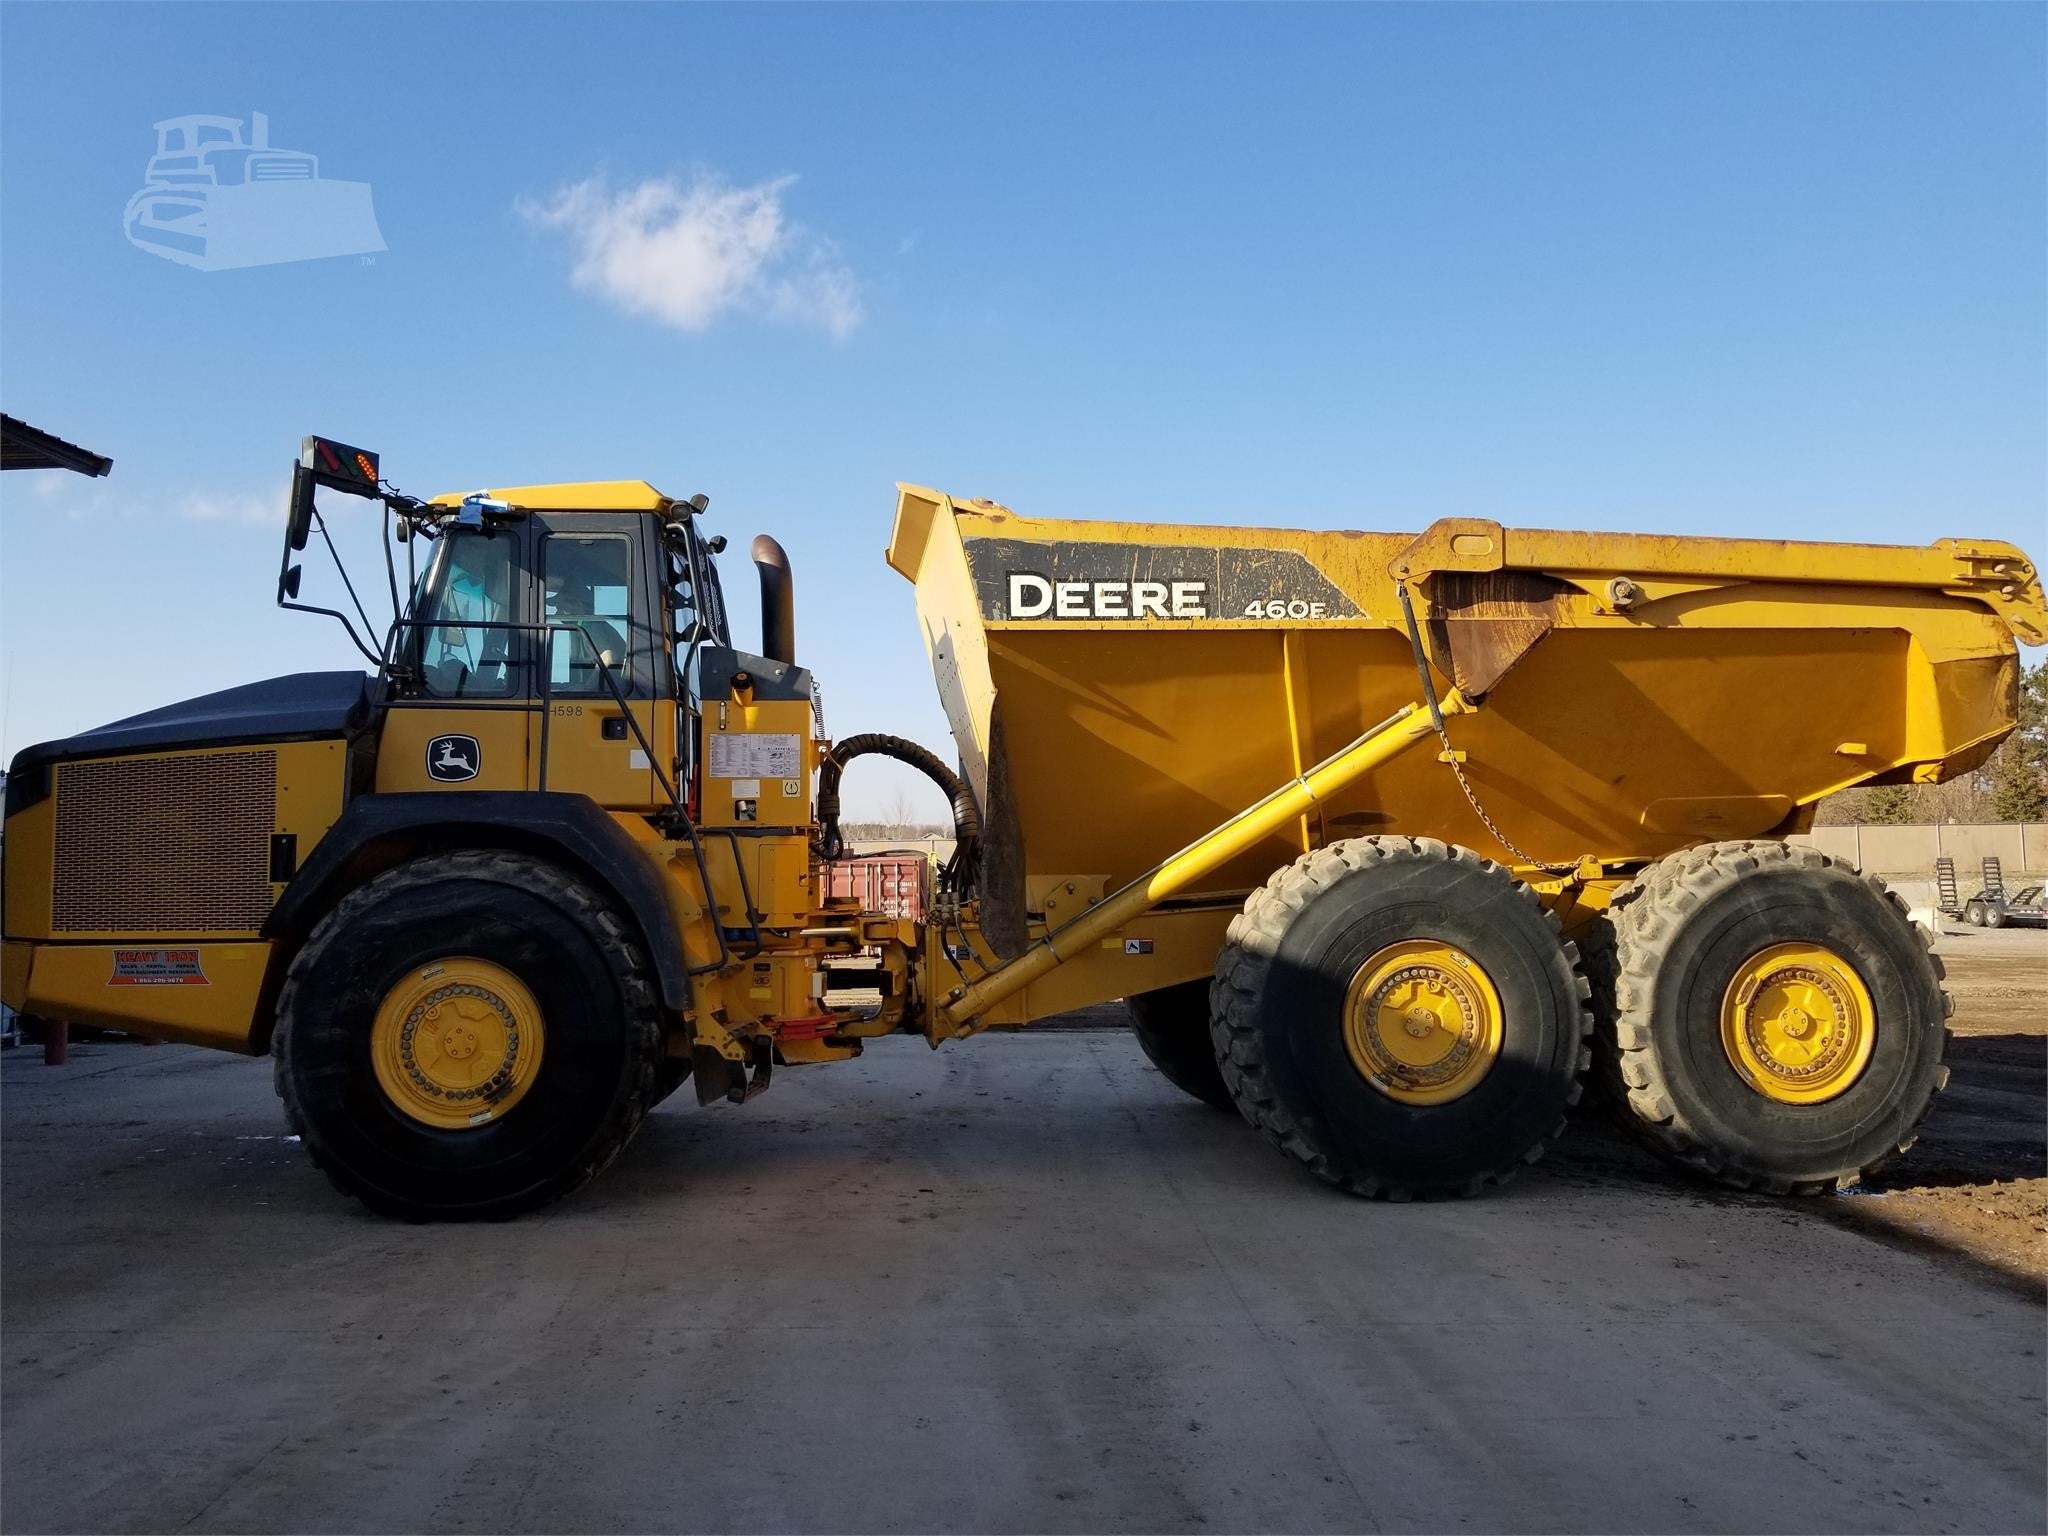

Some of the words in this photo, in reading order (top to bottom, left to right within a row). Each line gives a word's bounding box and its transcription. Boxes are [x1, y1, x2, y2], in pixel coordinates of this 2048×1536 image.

[1009, 575, 1206, 617] DEERE
[117, 951, 158, 962] HEAVY
[165, 951, 197, 962] IRON
